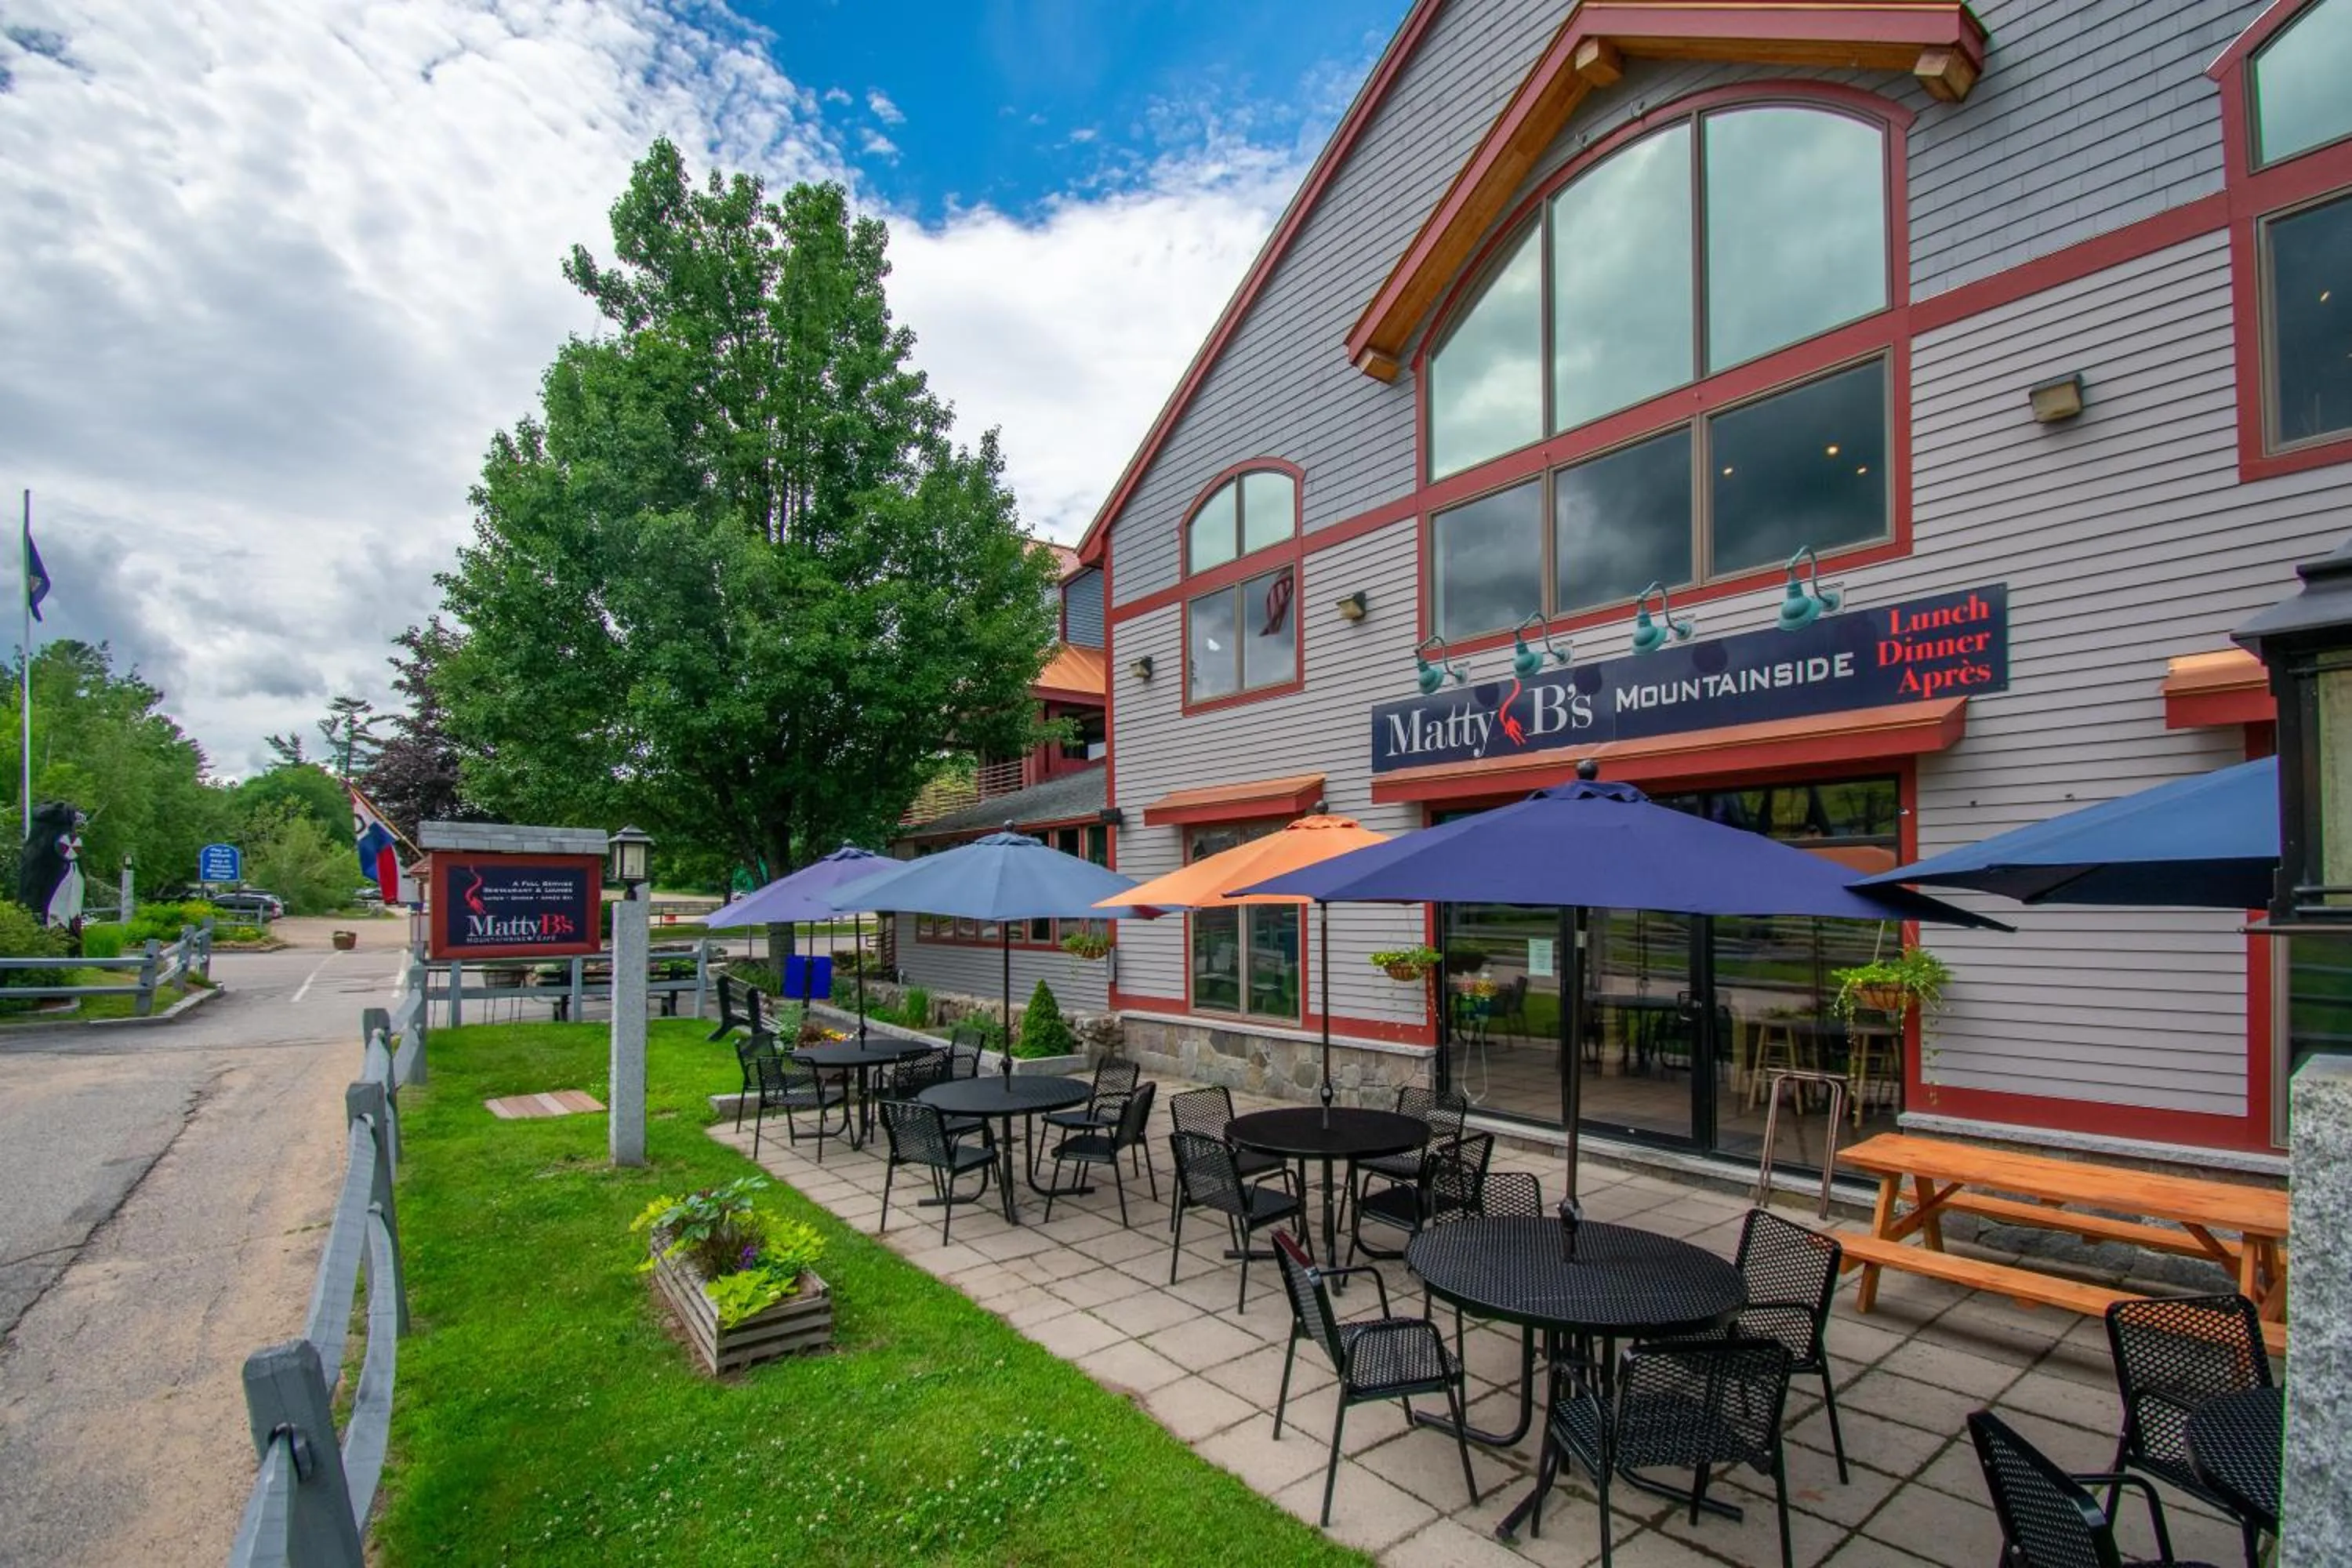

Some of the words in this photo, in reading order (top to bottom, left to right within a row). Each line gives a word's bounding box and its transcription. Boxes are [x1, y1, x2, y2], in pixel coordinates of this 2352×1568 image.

[1886, 592, 1990, 635] Lunch
[1877, 630, 1991, 666] Dinner
[1897, 659, 1992, 699] Après
[1385, 702, 1498, 758] Matty
[1525, 684, 1594, 737] B's
[1616, 652, 1855, 713] MOUNTAINSIDE
